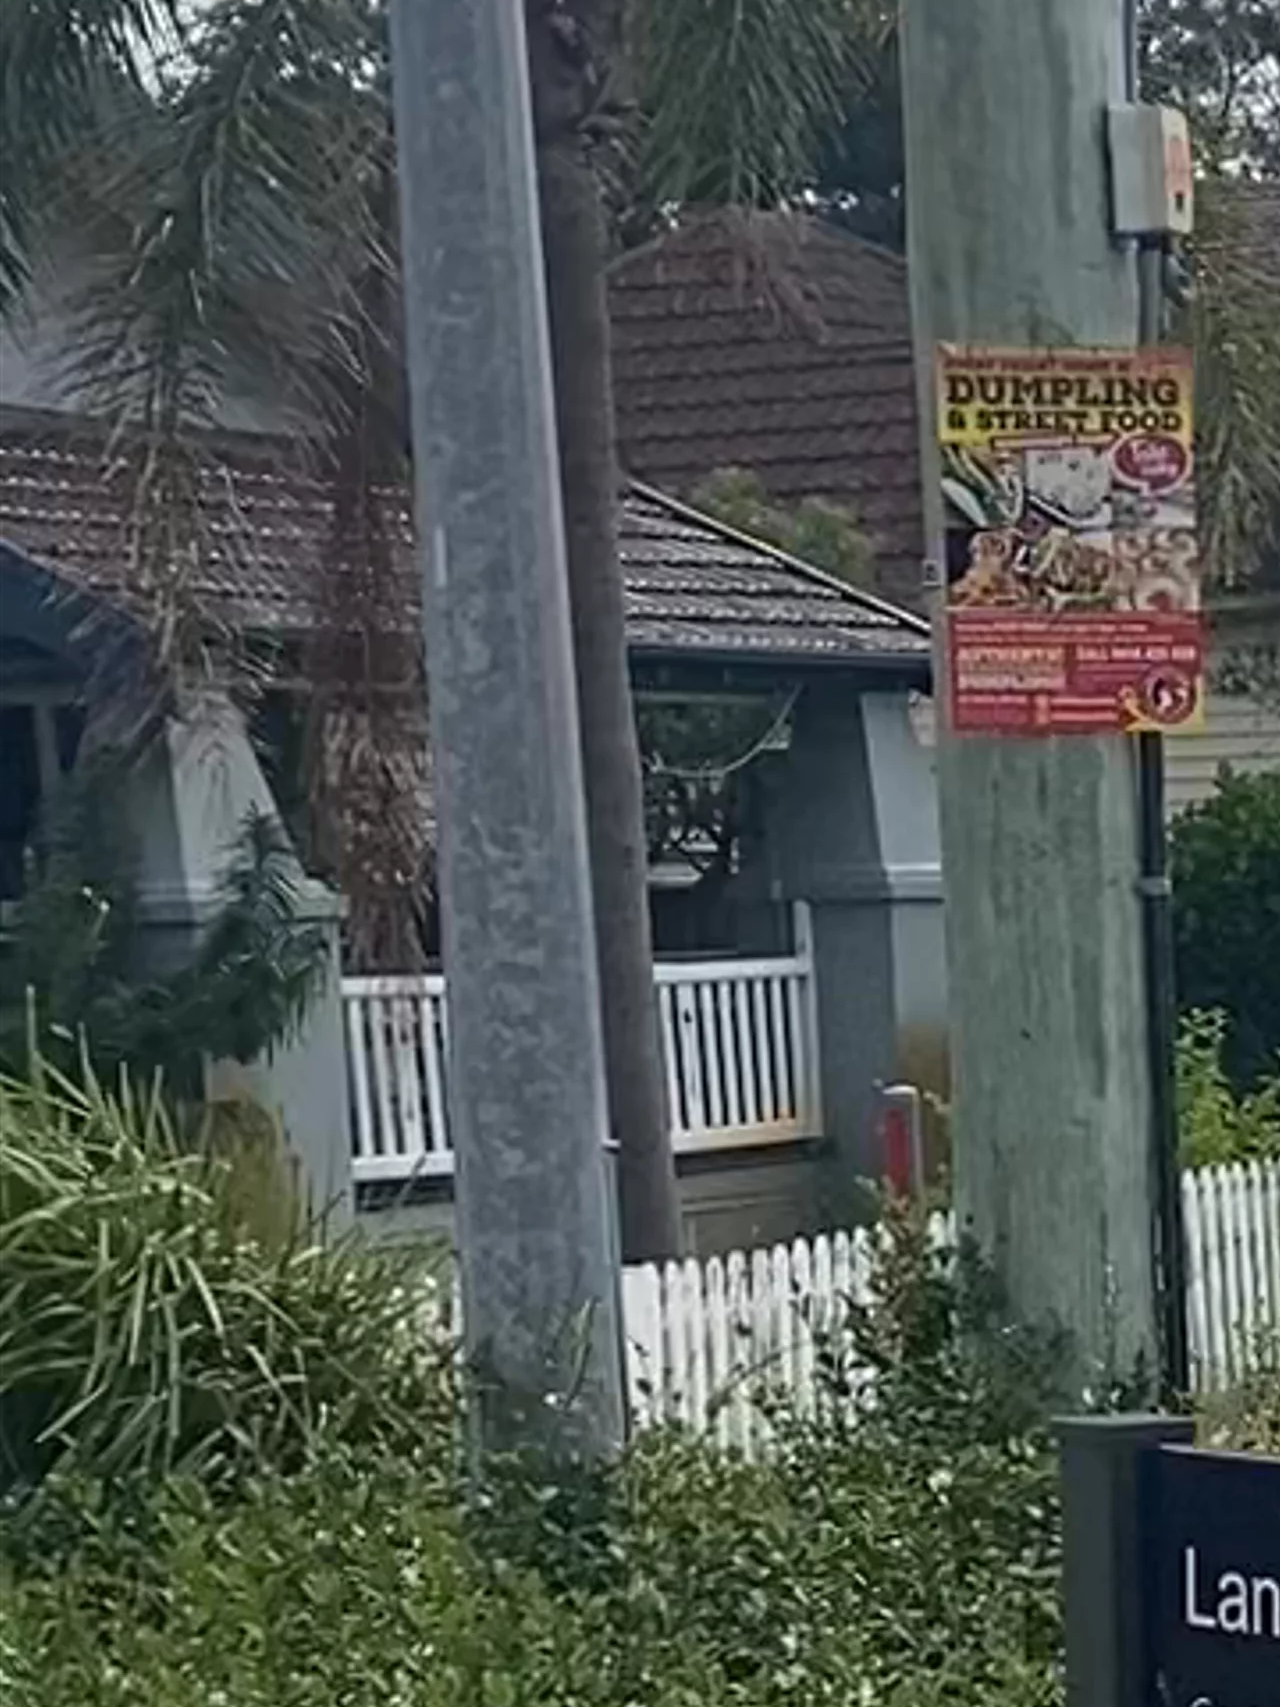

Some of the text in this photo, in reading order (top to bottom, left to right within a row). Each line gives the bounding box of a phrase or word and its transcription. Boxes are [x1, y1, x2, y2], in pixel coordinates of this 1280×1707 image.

[947, 374, 1180, 408] DUMPLING
[976, 410, 1088, 432] STREET
[1102, 410, 1183, 432] FOOD
